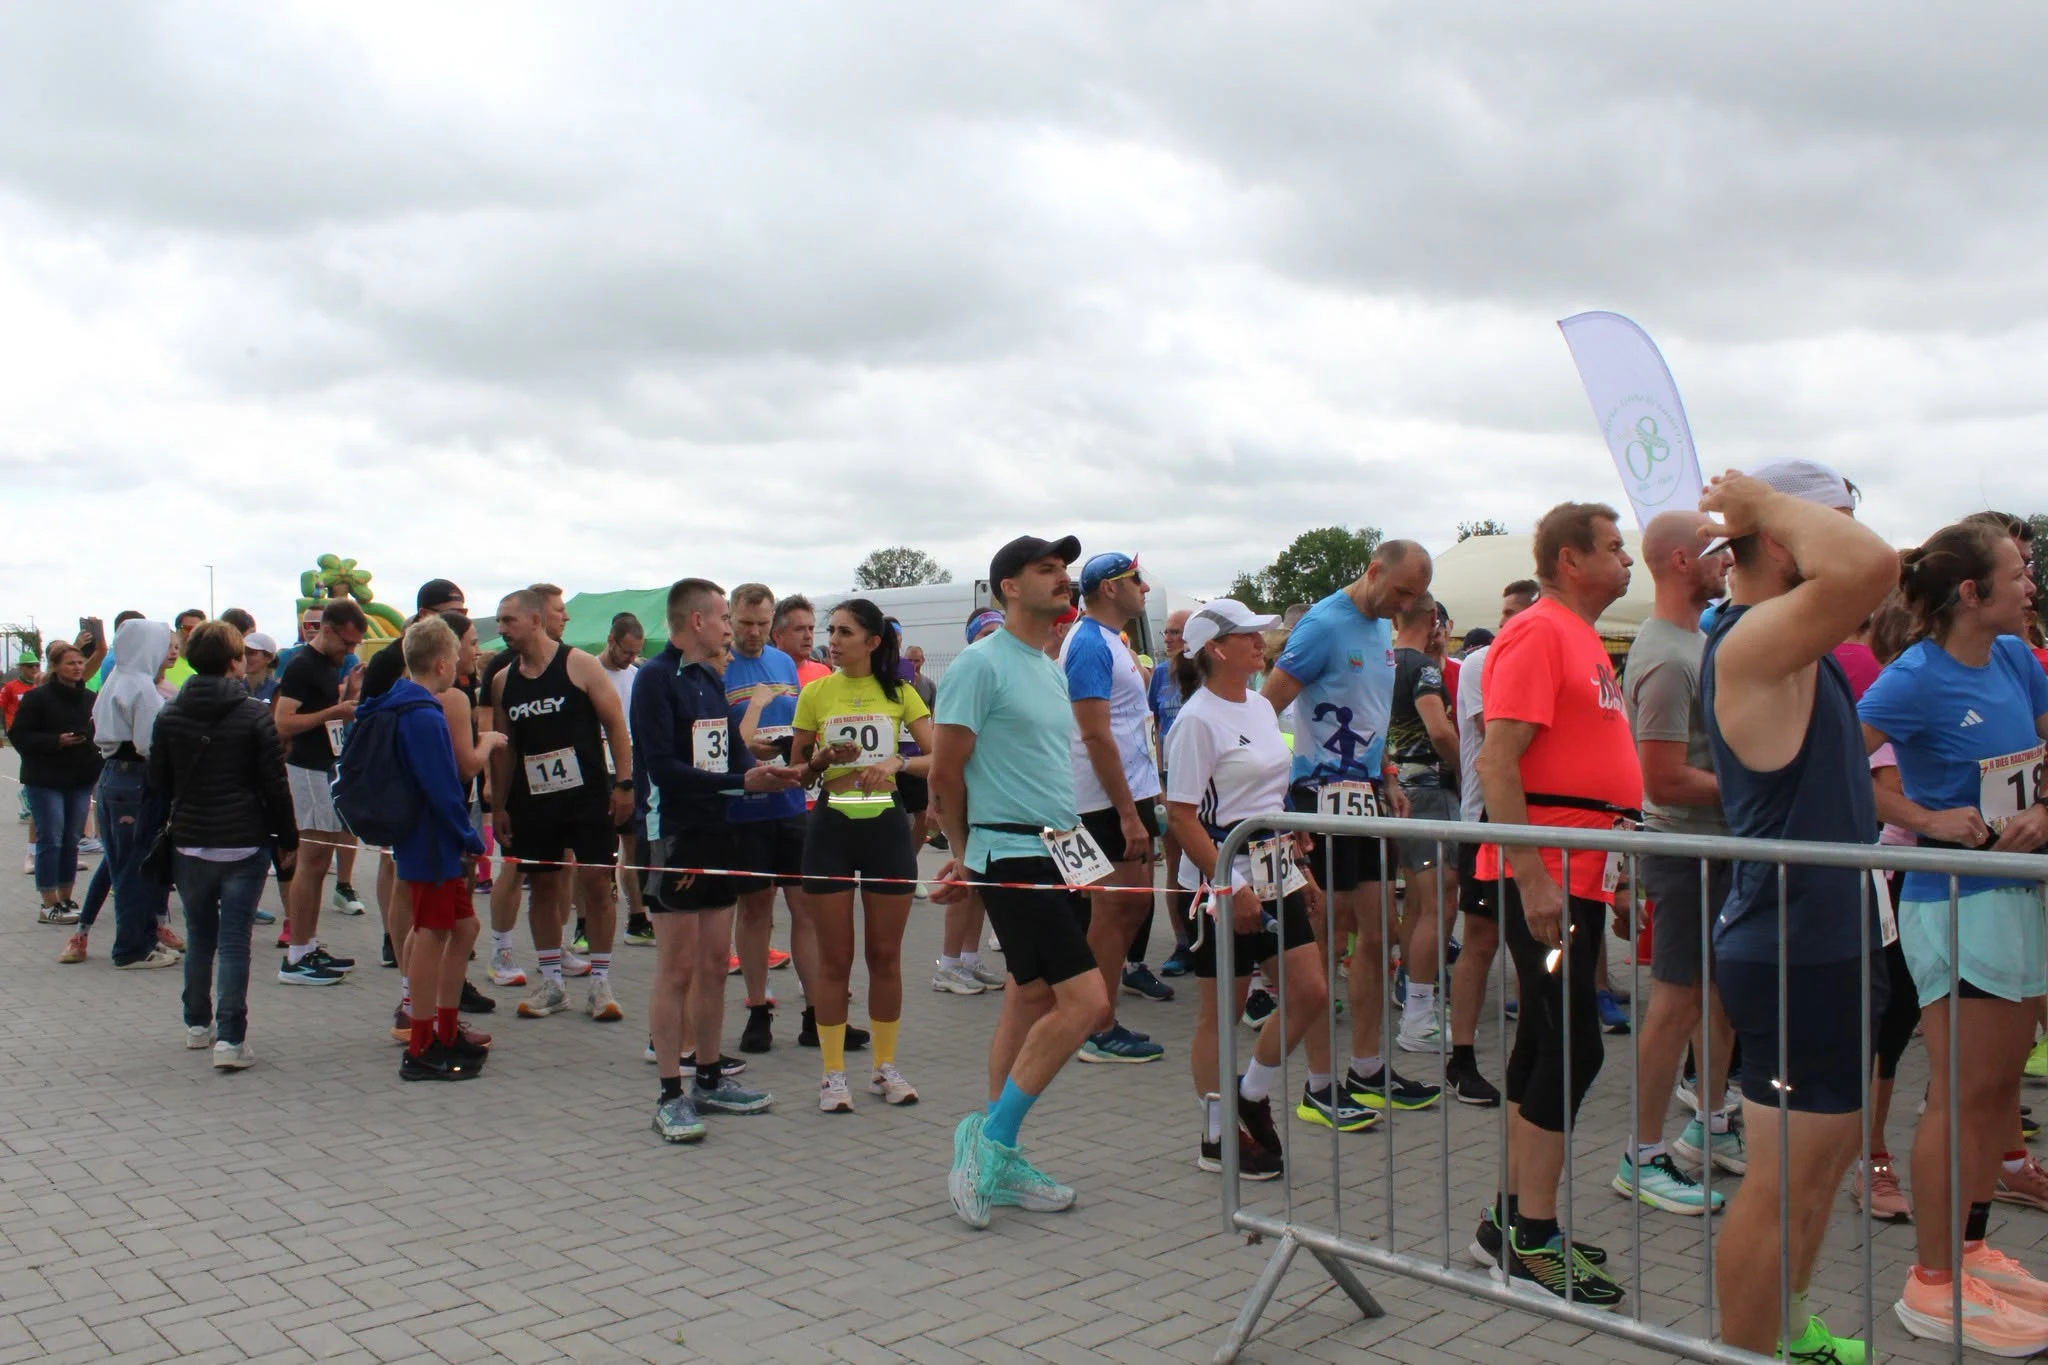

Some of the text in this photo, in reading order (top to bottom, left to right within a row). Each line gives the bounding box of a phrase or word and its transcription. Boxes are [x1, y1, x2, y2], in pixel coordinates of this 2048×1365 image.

[508, 696, 566, 721] OAKLEY
[536, 758, 568, 783] 14
[1326, 791, 1375, 817] 155
[1051, 832, 1098, 873] 154
